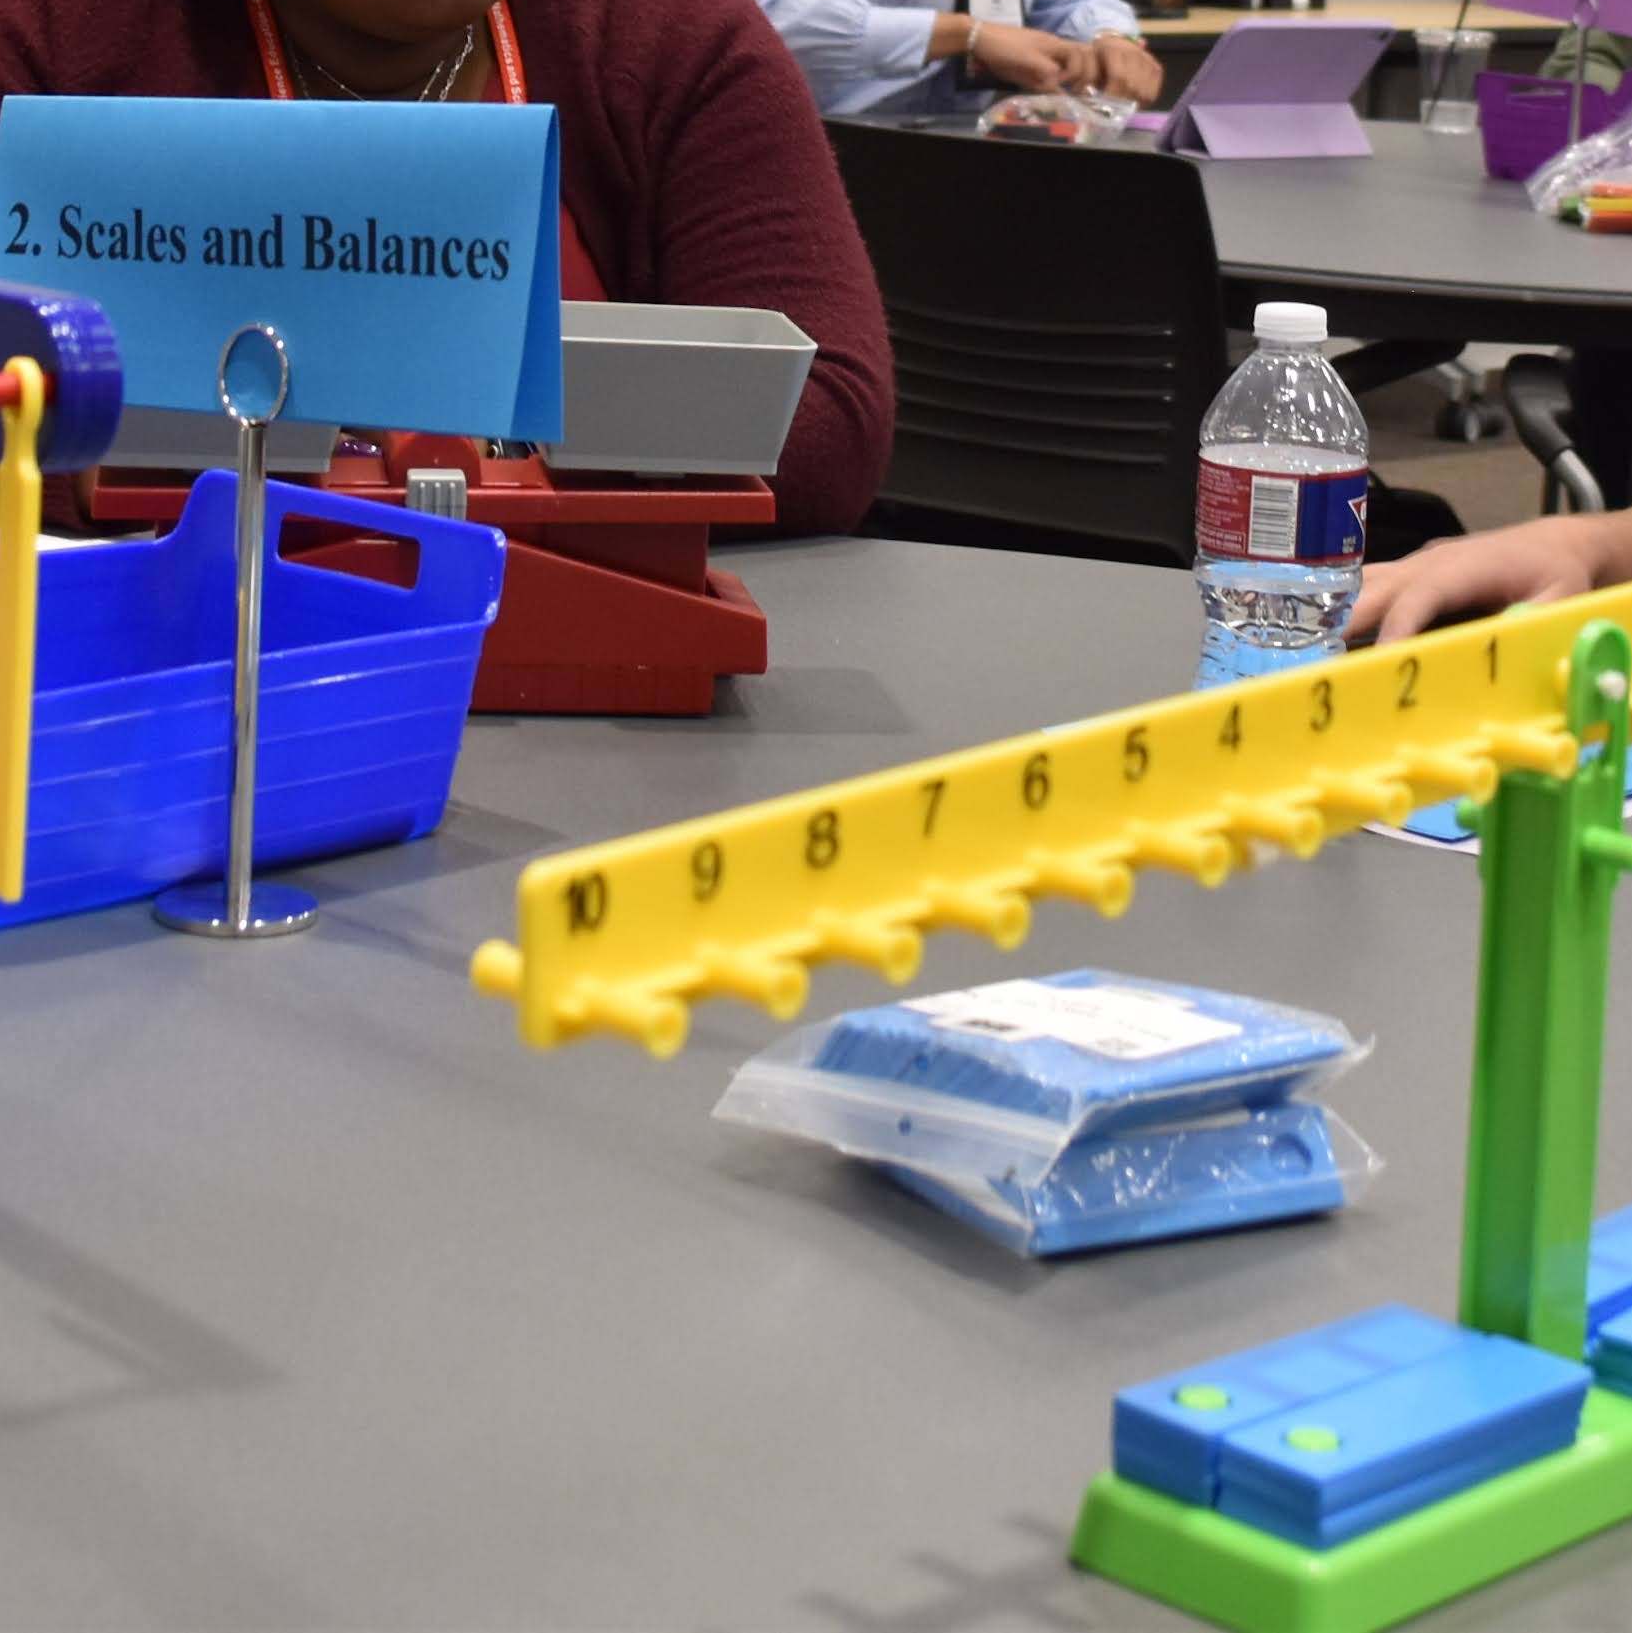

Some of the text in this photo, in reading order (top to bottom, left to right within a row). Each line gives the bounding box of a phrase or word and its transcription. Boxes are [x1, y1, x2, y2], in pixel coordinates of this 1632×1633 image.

[5, 202, 511, 281] 2. Scales and Balances
[564, 871, 608, 936] 10
[690, 839, 723, 904] 9
[804, 809, 840, 871] 8
[922, 778, 946, 839] 7
[1022, 752, 1051, 809] 6
[1123, 724, 1150, 783] 5
[1218, 702, 1243, 753] 4
[1310, 678, 1334, 733] 3
[1396, 656, 1420, 710] 2
[1484, 635, 1498, 685] 1
